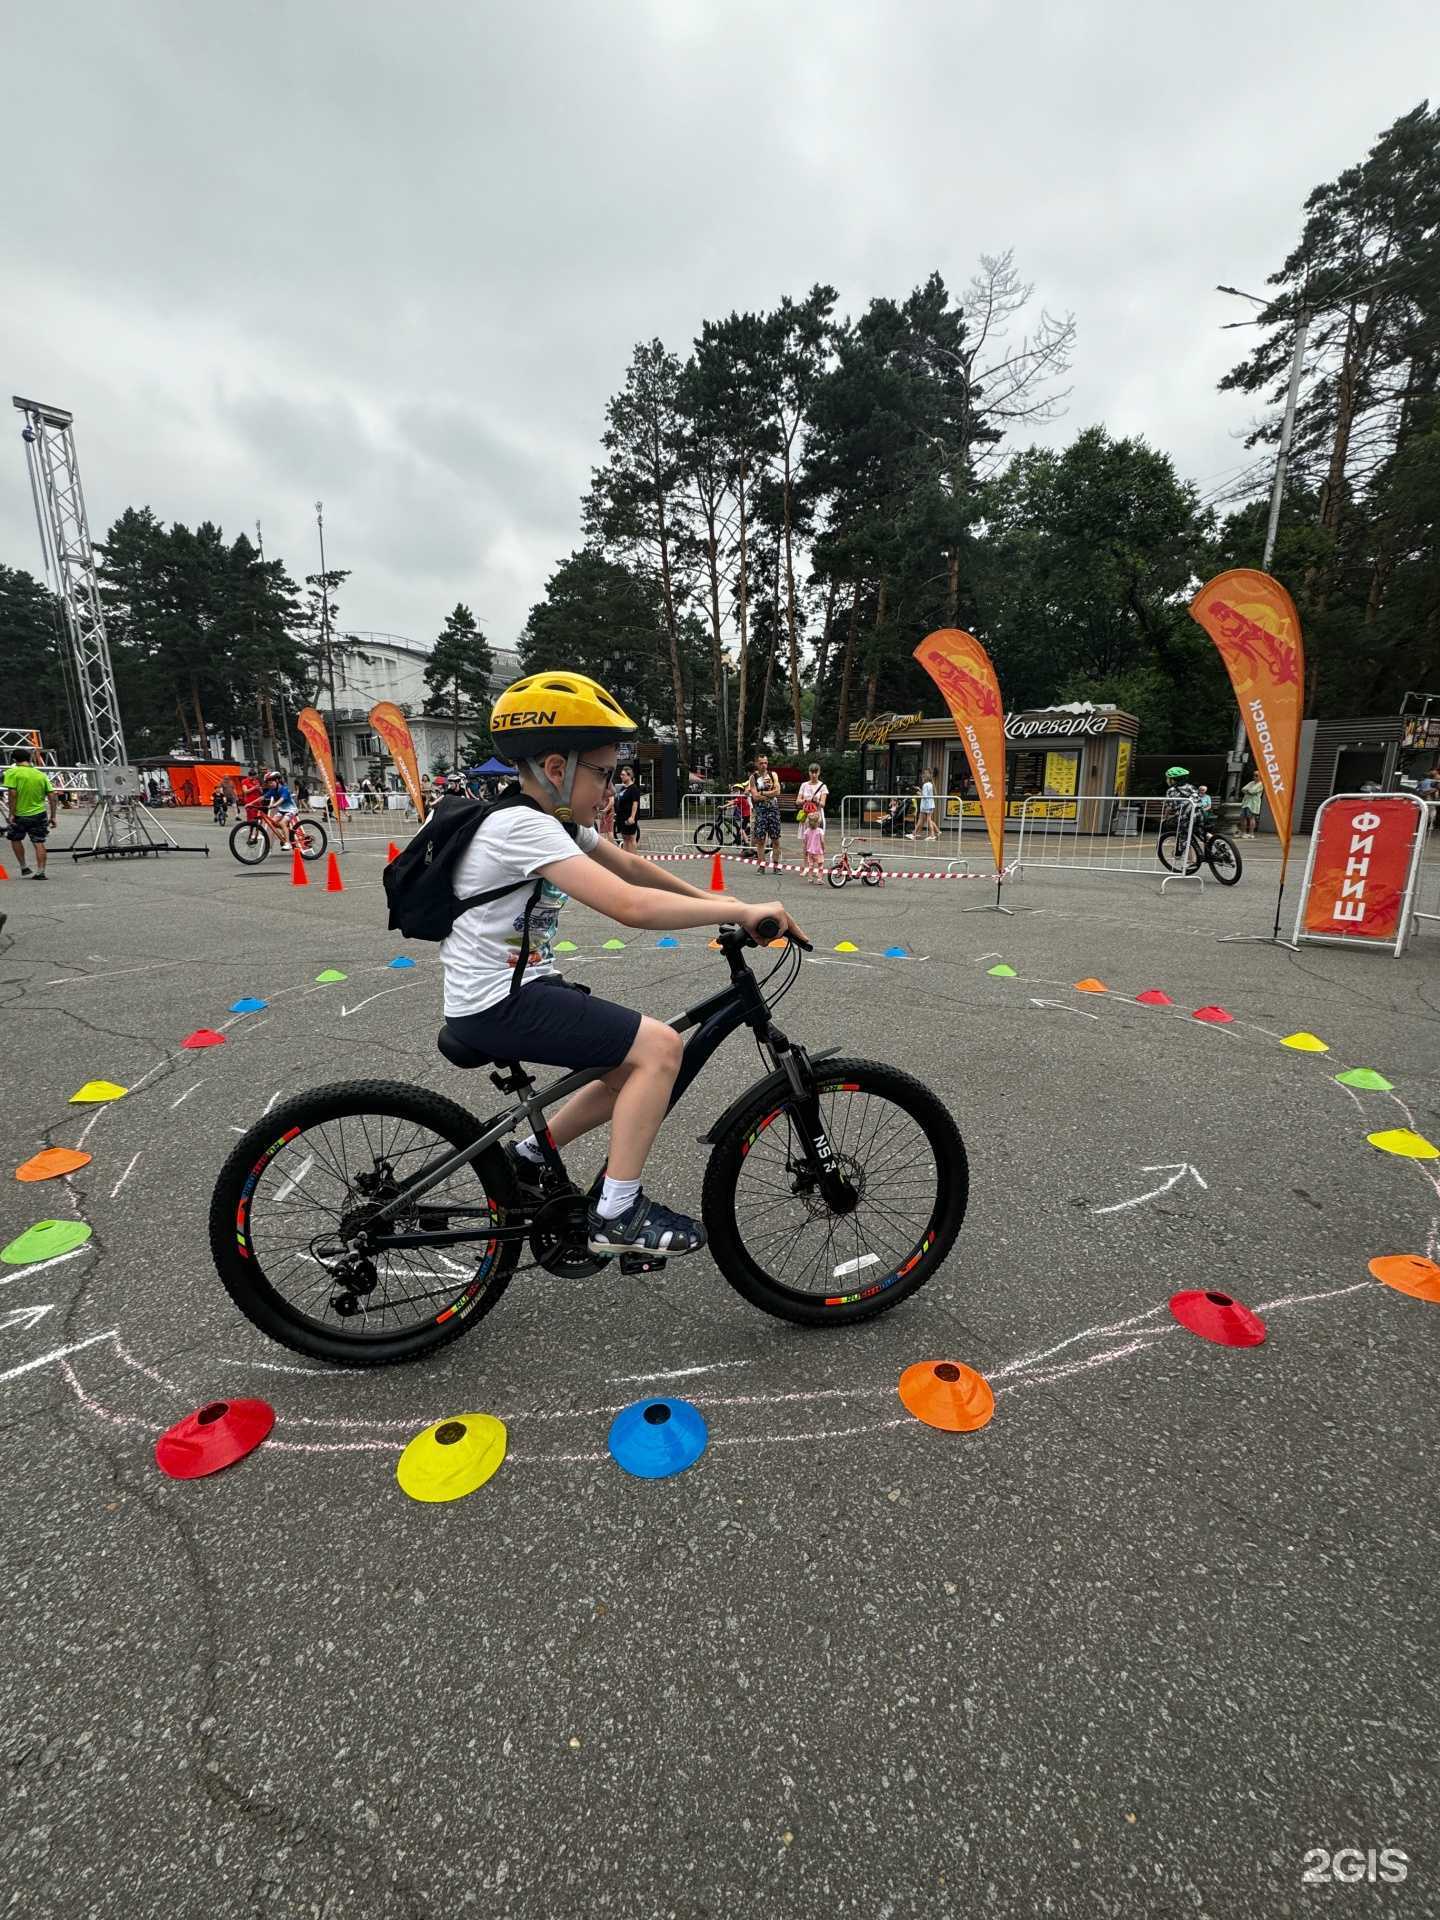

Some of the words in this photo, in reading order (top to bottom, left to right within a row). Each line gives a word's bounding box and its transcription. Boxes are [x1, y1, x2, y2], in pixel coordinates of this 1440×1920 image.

[492, 711, 556, 729] STERN
[1003, 712, 1108, 739] Кофеварка
[1332, 811, 1381, 922] ФИНИШ
[823, 1160, 837, 1173] 24
